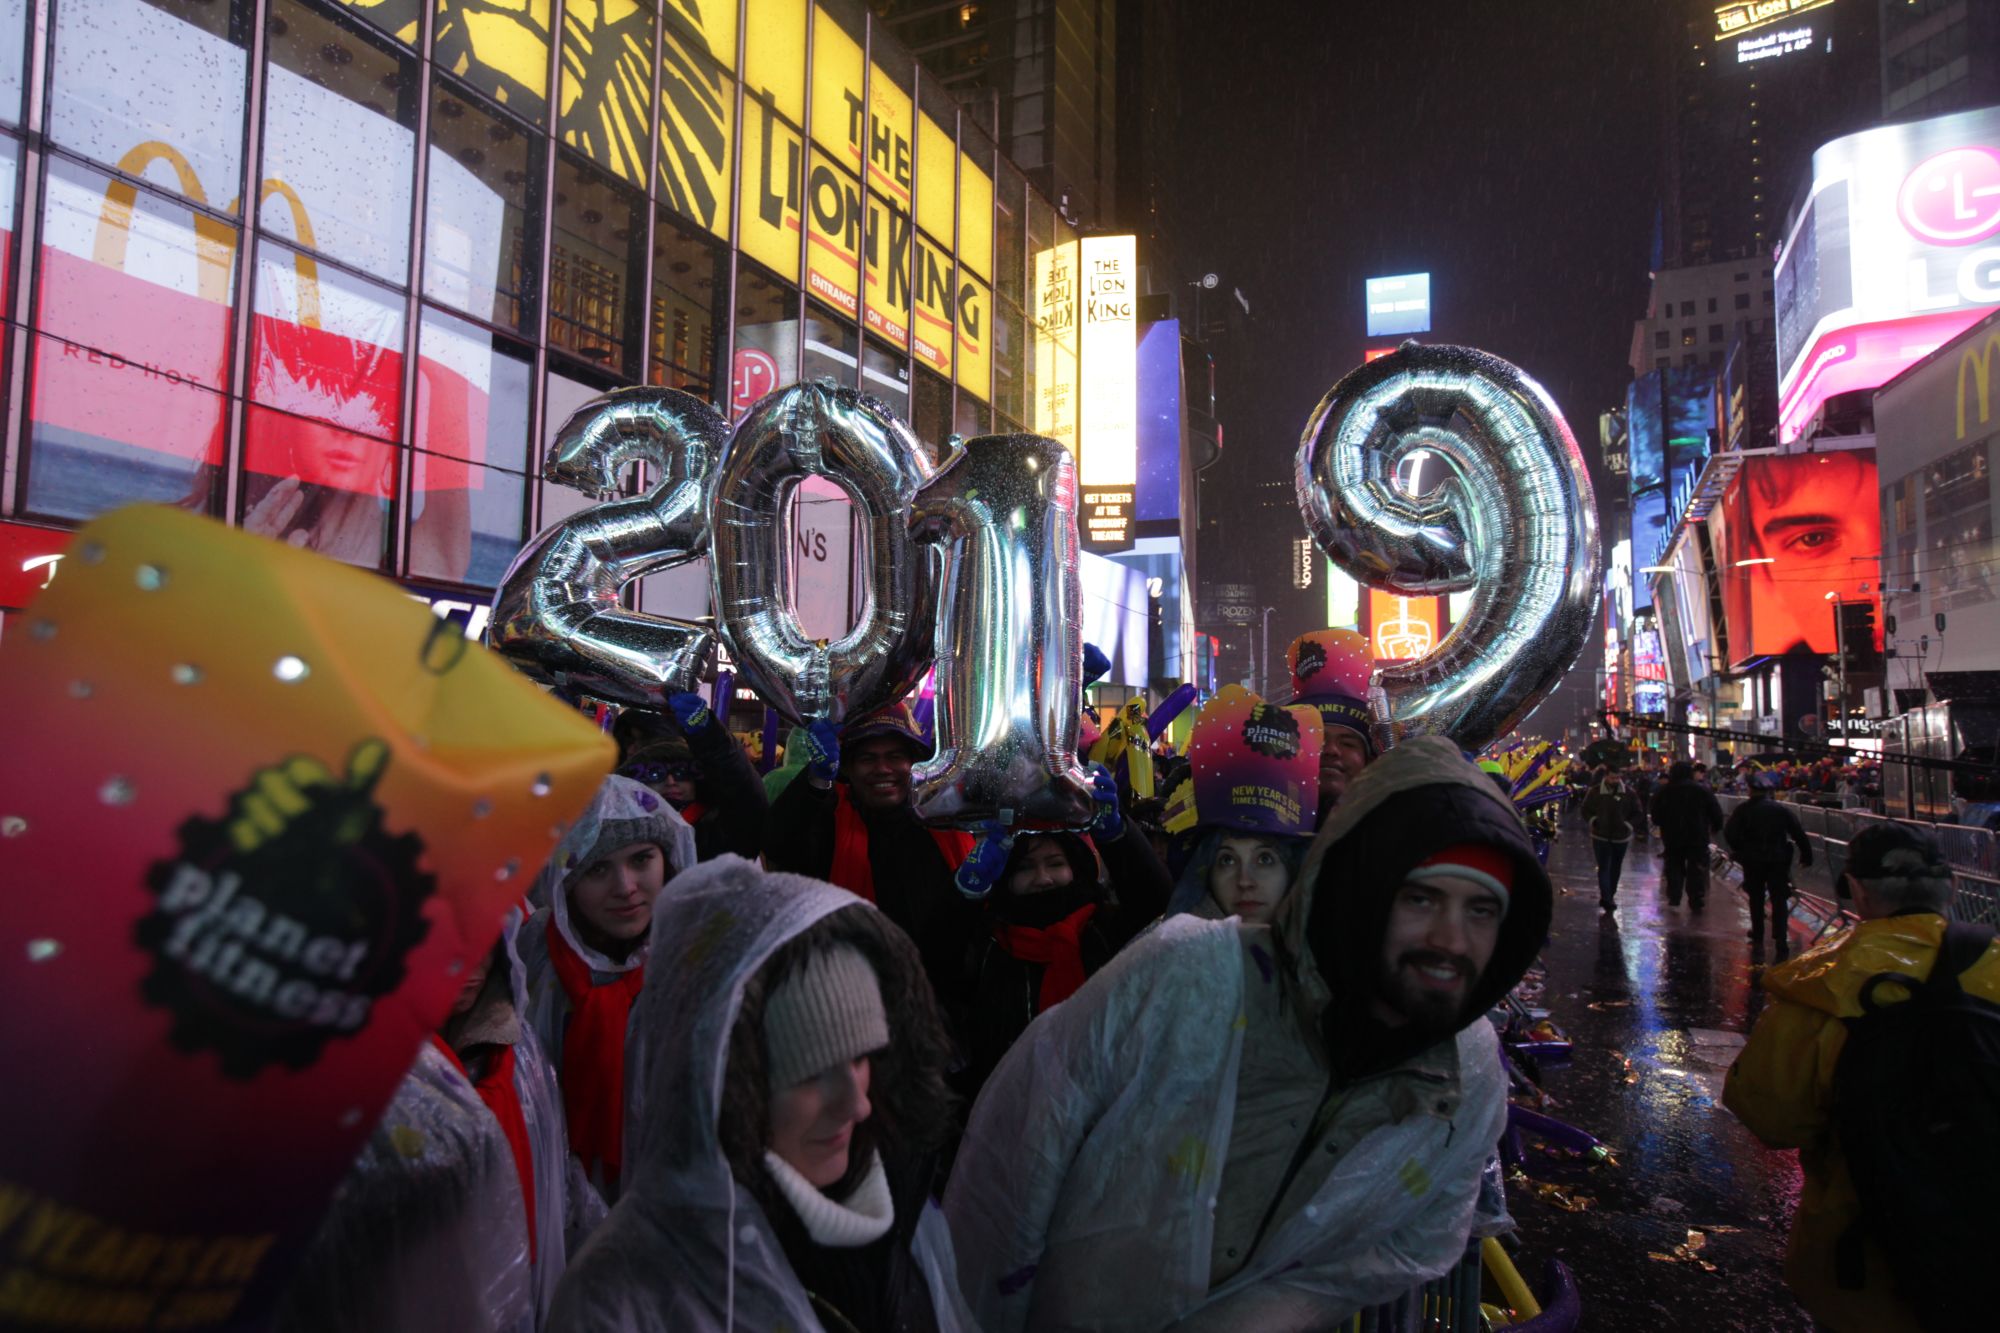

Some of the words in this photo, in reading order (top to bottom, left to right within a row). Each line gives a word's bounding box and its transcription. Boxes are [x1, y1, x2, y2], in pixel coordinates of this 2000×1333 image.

[1718, 11, 1749, 32] THE
[844, 87, 910, 191] THE
[759, 86, 878, 269] LION
[886, 195, 979, 342] KING
[1094, 259, 1119, 272] THE
[1090, 275, 1125, 297] LION
[811, 273, 857, 311] ENTRANCE
[868, 309, 881, 327] ON
[886, 320, 905, 342] 45TH
[915, 338, 937, 362] STREET
[1087, 298, 1131, 324] KING
[64, 341, 126, 370] RED
[144, 361, 200, 390] HOT
[1085, 494, 1100, 504] GET
[1101, 493, 1132, 504] TICKETS
[1095, 506, 1105, 516] AT
[1106, 505, 1121, 516] THE
[1301, 535, 1312, 589] NOVOTEL
[1217, 604, 1257, 618] FROZEN
[1318, 703, 1346, 714] ANET
[1247, 725, 1290, 741] planet
[1252, 733, 1297, 754] fitness
[1232, 785, 1256, 796] NEW
[1258, 786, 1288, 806] YEAR'S
[1232, 797, 1257, 805] TIMES
[159, 863, 370, 980] planet
[165, 912, 372, 1030] fitness
